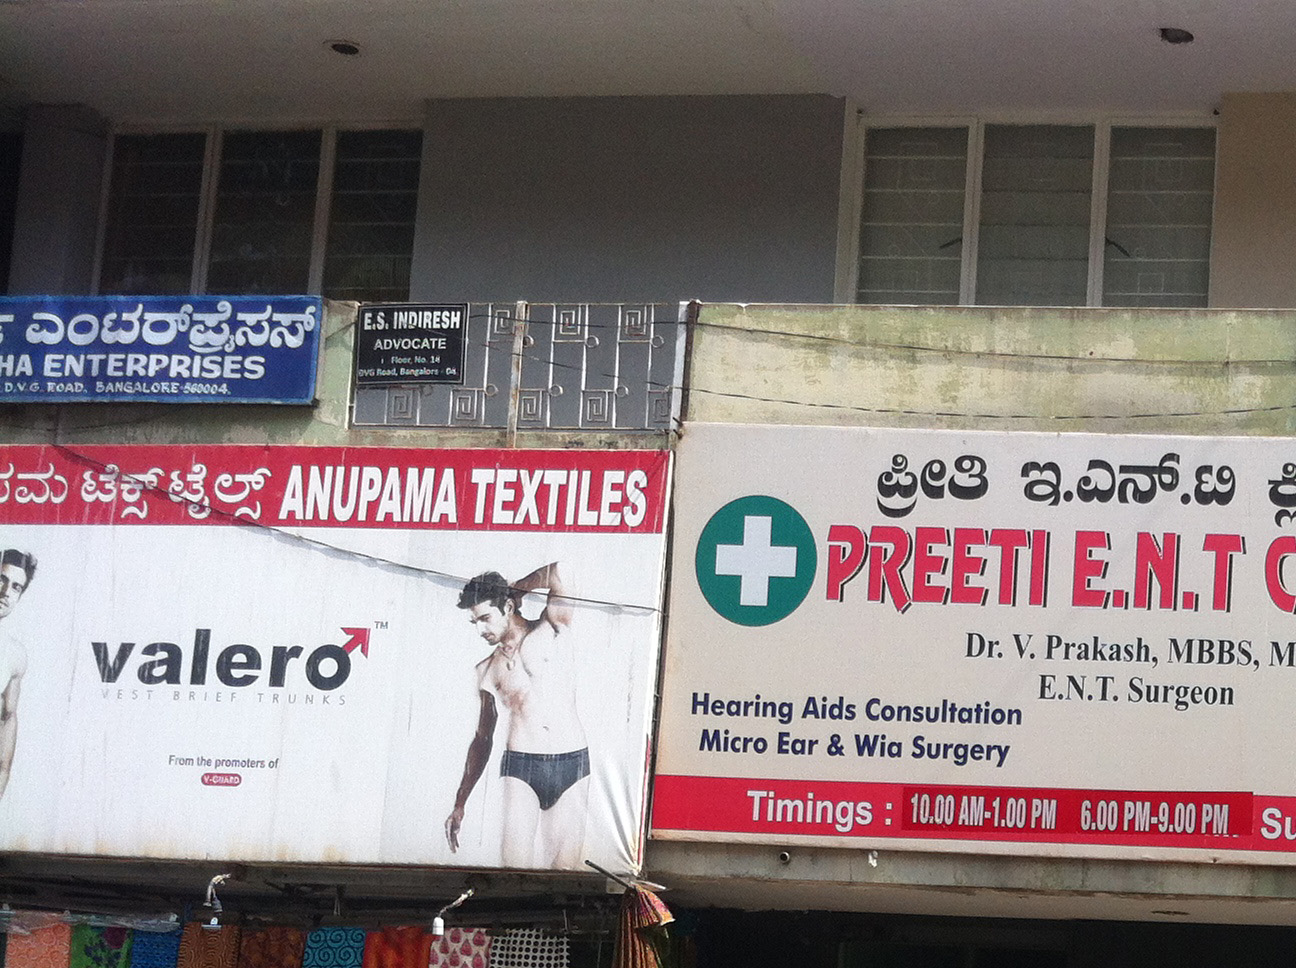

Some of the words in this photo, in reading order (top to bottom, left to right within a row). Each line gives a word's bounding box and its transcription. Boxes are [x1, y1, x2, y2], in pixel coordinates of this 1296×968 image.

[364, 312, 389, 330] E.S.
[393, 311, 460, 330] INDIRESH
[373, 338, 447, 350] ADVOCATE
[43, 354, 265, 379] ENTERPRISES
[278, 465, 458, 524] ANUPAMA
[471, 468, 648, 528] TEXTILES
[876, 453, 989, 519] ಪ್ರೀತಿ
[825, 524, 1050, 614] PREETI
[1071, 530, 1247, 612] E.N.T
[90, 628, 352, 692] valero
[964, 632, 1003, 659] Dr.
[1012, 634, 1036, 660] V.
[1045, 634, 1159, 668] Prakash,
[1166, 638, 1260, 672] MBBS,
[101, 688, 153, 701] VEST
[172, 690, 237, 703] BRIEF
[257, 692, 346, 706] TRUNKS
[691, 692, 794, 725] Hearing
[801, 696, 857, 721] Aids
[865, 698, 1023, 725] Consultation
[1038, 674, 1119, 702] E.N.T.
[1127, 677, 1235, 712] Surgeon
[168, 755, 195, 767] From
[197, 756, 213, 768] the
[214, 758, 266, 770] promoters
[268, 757, 279, 769] of
[699, 729, 768, 754] Micro
[777, 732, 819, 755] Ear
[827, 734, 845, 757] &
[854, 734, 903, 758] Wia
[911, 735, 1010, 768] Surgery
[746, 790, 873, 832] Timings
[910, 793, 955, 825] 10.00
[958, 795, 1027, 829] AM-1.00
[1030, 798, 1057, 830] PM
[1080, 800, 1118, 832] 6.00
[1122, 801, 1197, 834] PM-9.00
[1201, 803, 1229, 835] PM
